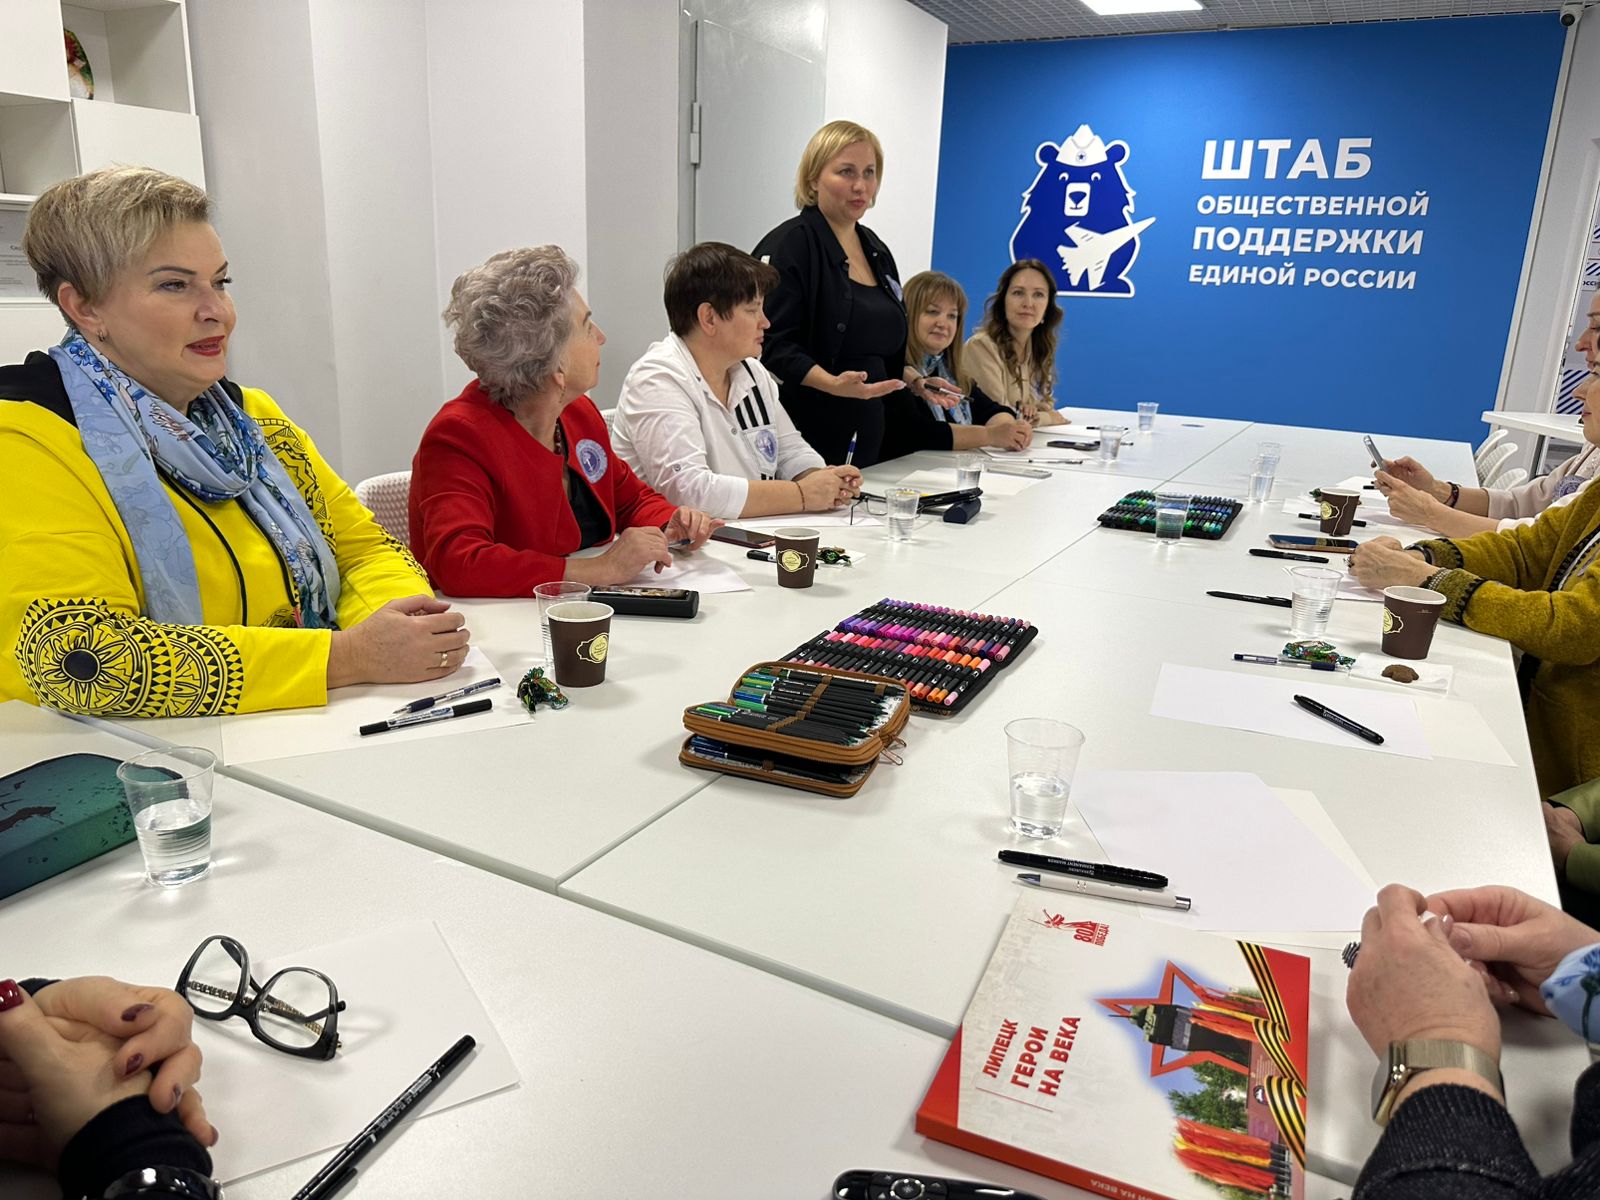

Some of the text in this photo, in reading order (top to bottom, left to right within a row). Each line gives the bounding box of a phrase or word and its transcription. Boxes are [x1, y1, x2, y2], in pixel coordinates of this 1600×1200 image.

[1201, 138, 1372, 180] ШТАБ
[1197, 191, 1429, 217] ОБЩЕСТВЕННОЙ
[1192, 227, 1424, 256] ПОДДЕРЖКИ
[1188, 263, 1417, 290] ЕДИНОЙ РОССИИ
[1073, 928, 1094, 942] 80
[982, 1019, 1018, 1078] ЛИПЕЦК
[1010, 1026, 1048, 1088] ГЕРОИ
[1038, 1016, 1081, 1097] НА ВЕКА
